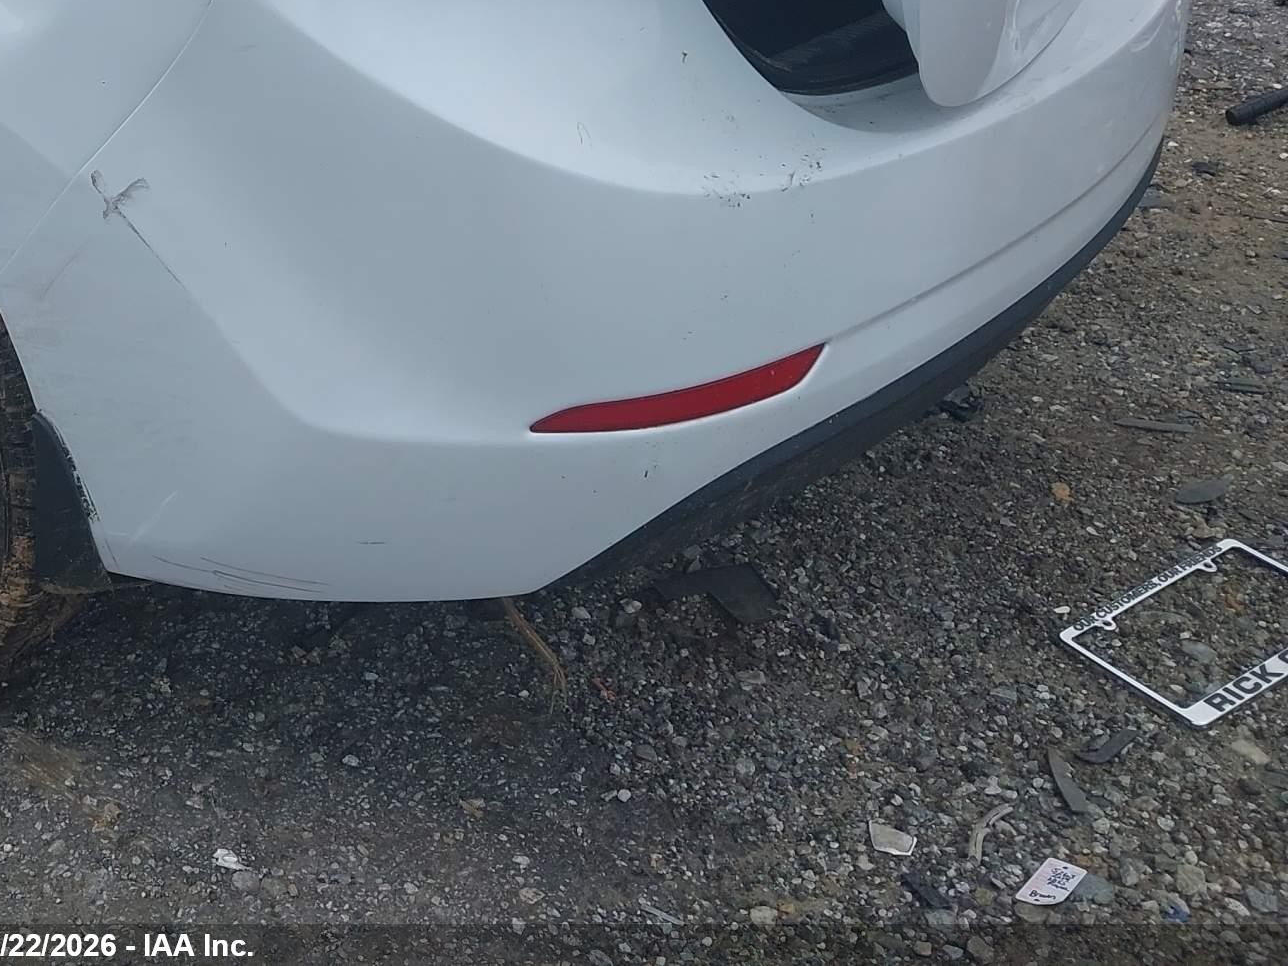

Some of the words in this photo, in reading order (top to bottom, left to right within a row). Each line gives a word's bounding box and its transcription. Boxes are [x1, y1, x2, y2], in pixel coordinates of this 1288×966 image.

[1073, 614, 1099, 631] OUR
[1096, 580, 1161, 619] CUSTOMERS,
[1158, 565, 1184, 583] OUR
[1179, 545, 1223, 571] FRIENDS
[1203, 663, 1285, 713] RICK
